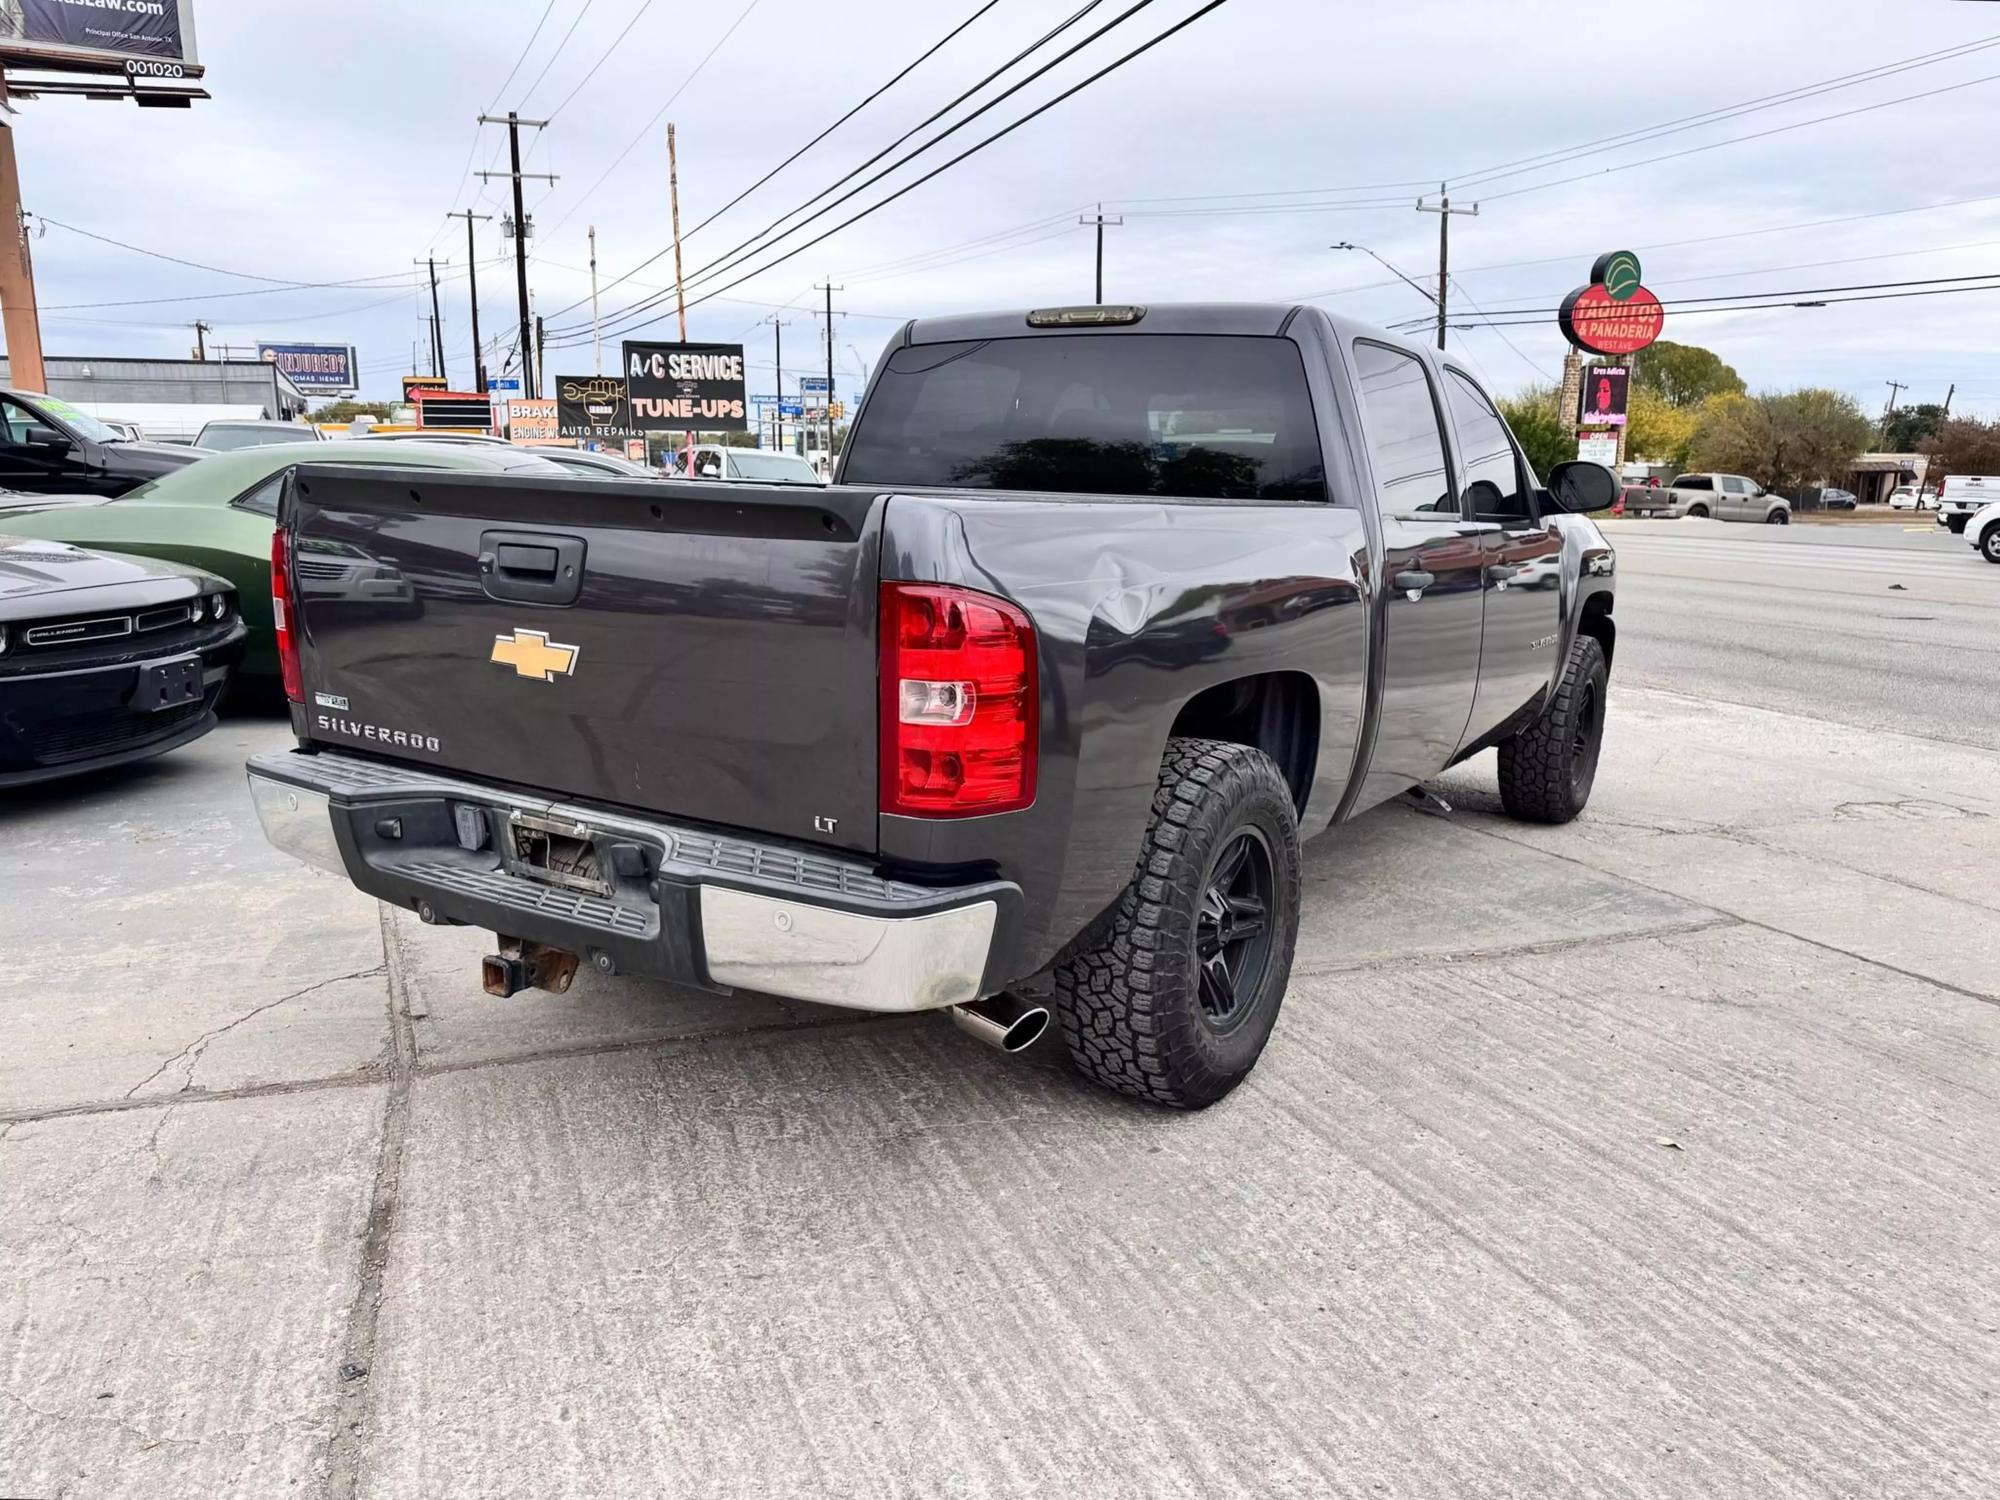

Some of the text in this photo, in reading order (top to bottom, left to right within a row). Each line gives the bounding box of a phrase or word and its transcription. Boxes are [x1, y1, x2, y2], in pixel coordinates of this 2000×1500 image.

[85, 27, 110, 37] Principal
[111, 31, 128, 39] Office
[126, 60, 183, 78] 001020
[1577, 298, 1660, 324] TAQUITOS
[1579, 322, 1654, 340] & PANADERIA
[1597, 340, 1617, 350] WEST
[278, 352, 346, 373] INJURED?
[630, 352, 743, 381] A/C SERVICE
[631, 398, 745, 419] TUNE-UPS
[512, 426, 546, 440] ENGINE
[561, 426, 591, 436] AUTO
[318, 715, 440, 753] SILVERADO
[814, 815, 838, 834] LT
